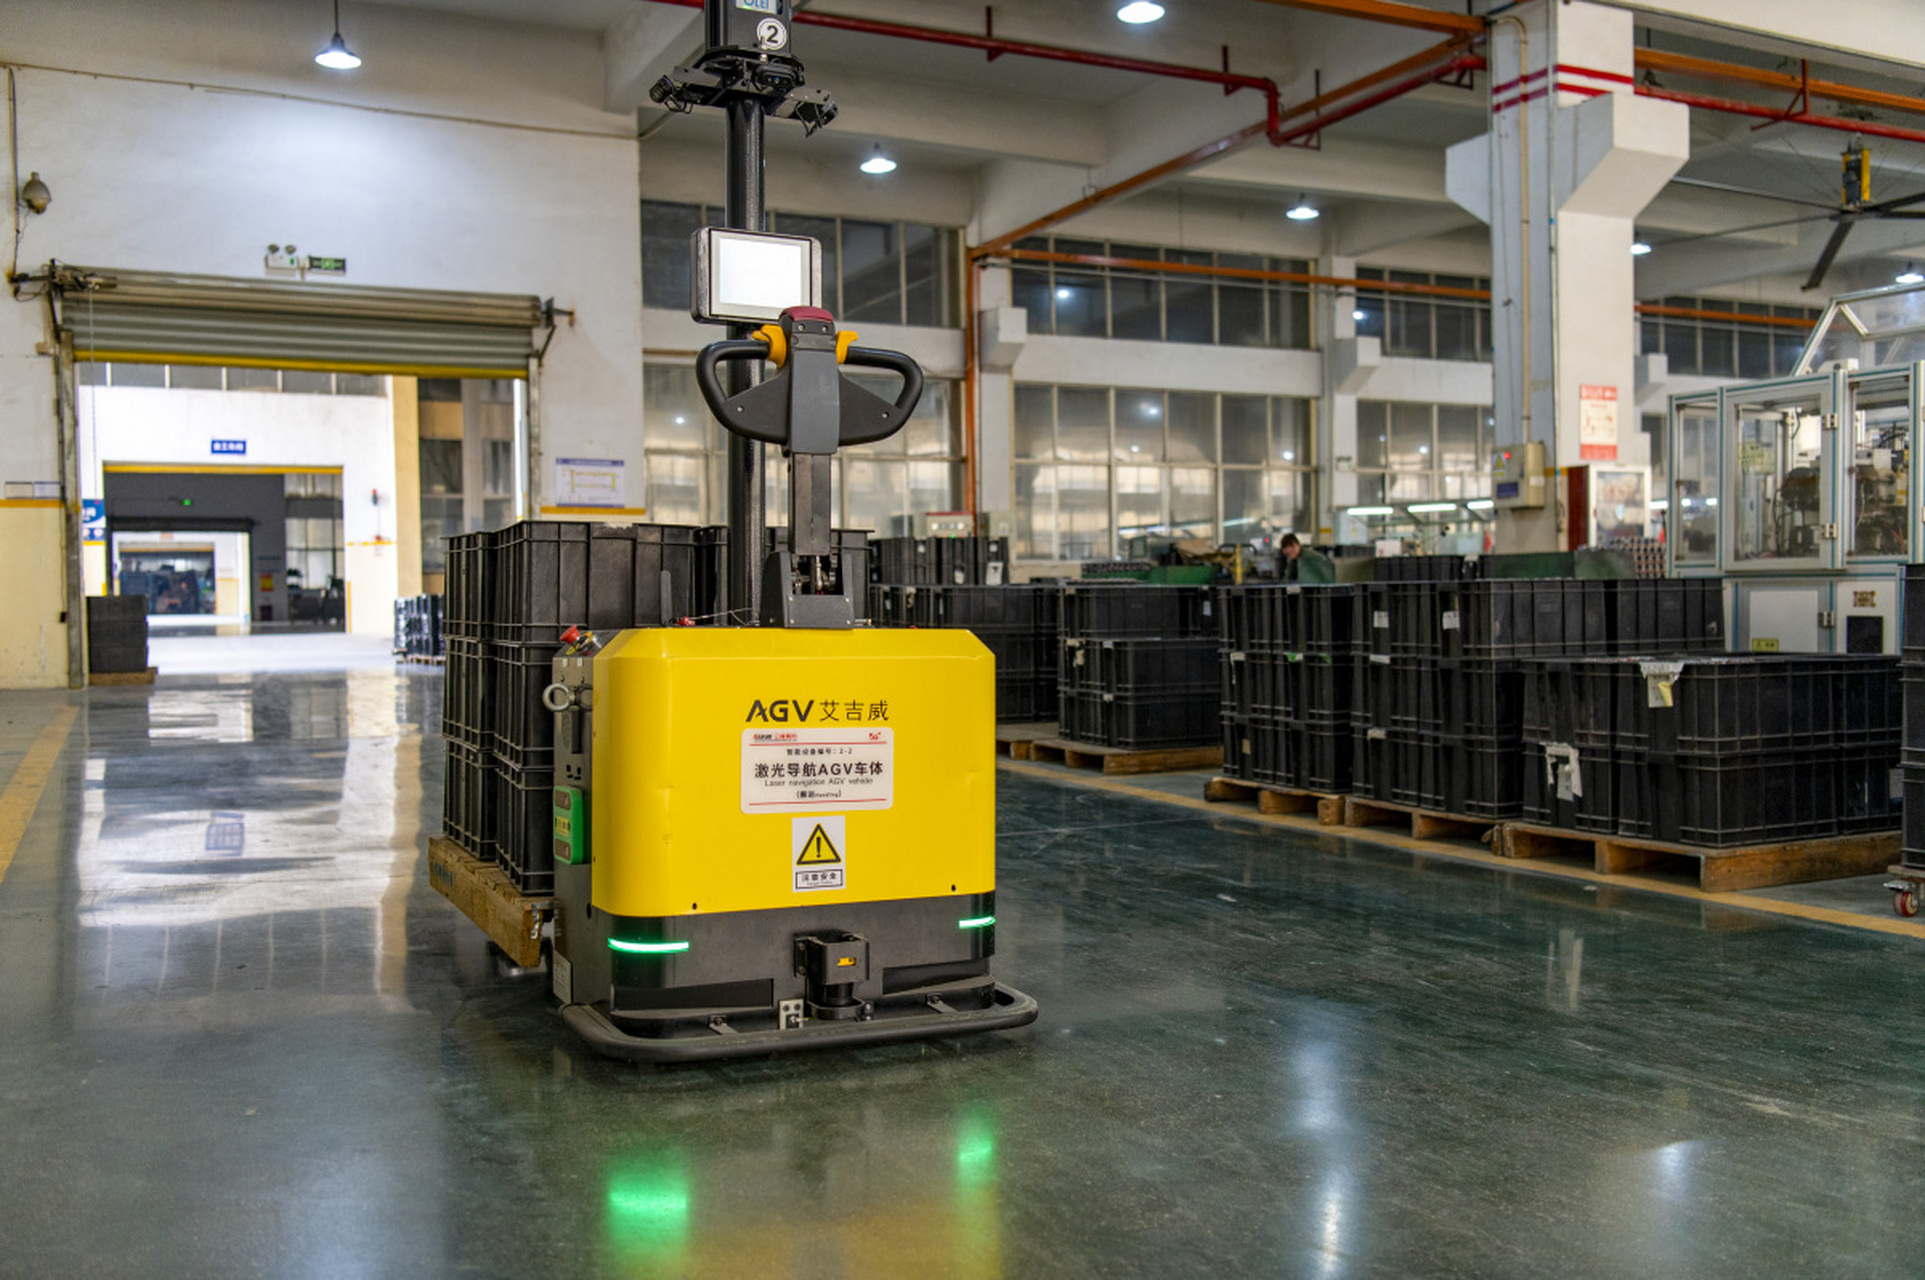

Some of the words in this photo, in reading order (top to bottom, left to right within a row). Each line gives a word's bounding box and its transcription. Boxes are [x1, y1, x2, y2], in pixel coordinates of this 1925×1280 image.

[767, 25, 778, 43] 2
[746, 699, 814, 722] AGV
[819, 699, 890, 722] 艾吉威
[754, 761, 883, 778] 激光导航AGV车体
[764, 779, 785, 787] Laser
[788, 778, 826, 788] navigation
[828, 777, 846, 785] AGV
[848, 776, 873, 785] vehicle
